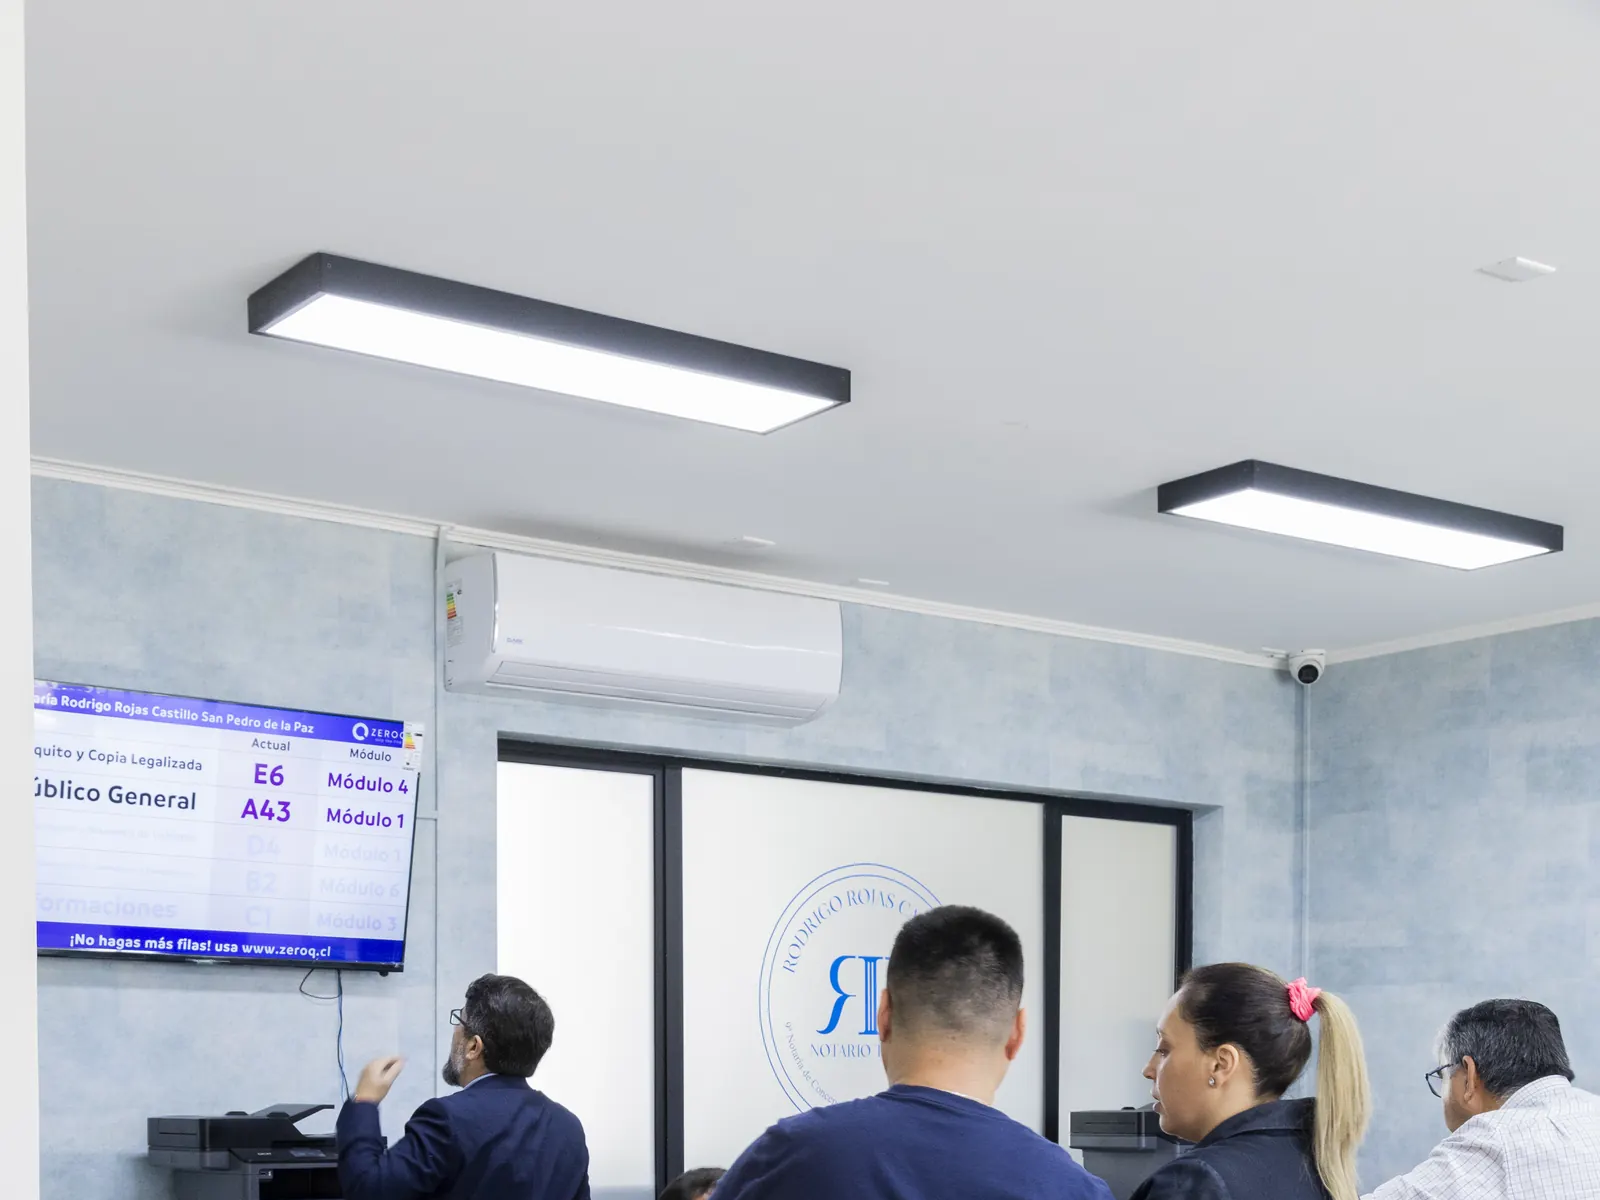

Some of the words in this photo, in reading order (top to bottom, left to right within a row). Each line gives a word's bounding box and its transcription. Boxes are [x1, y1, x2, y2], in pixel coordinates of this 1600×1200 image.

[61, 695, 111, 713] Rodrigo
[114, 701, 149, 717] Rojas
[151, 706, 199, 721] Castillo
[201, 711, 223, 725] San
[226, 714, 261, 728] Pedro
[263, 718, 279, 730] de
[281, 719, 292, 731] la
[294, 723, 315, 734] Paz
[251, 738, 291, 751] Actual
[350, 748, 392, 762] Módulo
[76, 751, 84, 761] y
[88, 749, 127, 765] Copia
[131, 753, 203, 771] Legalizada
[254, 763, 285, 786] E6
[328, 772, 393, 793] Módulo
[398, 779, 409, 794] 4
[108, 785, 197, 810] General
[241, 798, 292, 823] A43
[326, 808, 392, 828] Módulo
[397, 814, 405, 828] 1
[247, 835, 281, 856] D4
[324, 842, 388, 863] Módulo
[393, 847, 402, 862] 1
[246, 872, 277, 892] B2
[319, 875, 385, 897] Módulo
[388, 882, 401, 897] 6
[245, 907, 273, 929] C1
[316, 910, 382, 931] Módulo
[386, 917, 398, 932] 3
[783, 895, 842, 973] RODRIGO
[846, 888, 896, 908] ROJAS
[70, 933, 95, 948] ¡No
[98, 934, 140, 950] hagas
[145, 937, 173, 949] más
[177, 938, 211, 952] filas!
[215, 942, 239, 953] usa
[242, 943, 331, 959] www.zeroq.cl
[811, 1043, 871, 1058] NOTARIO
